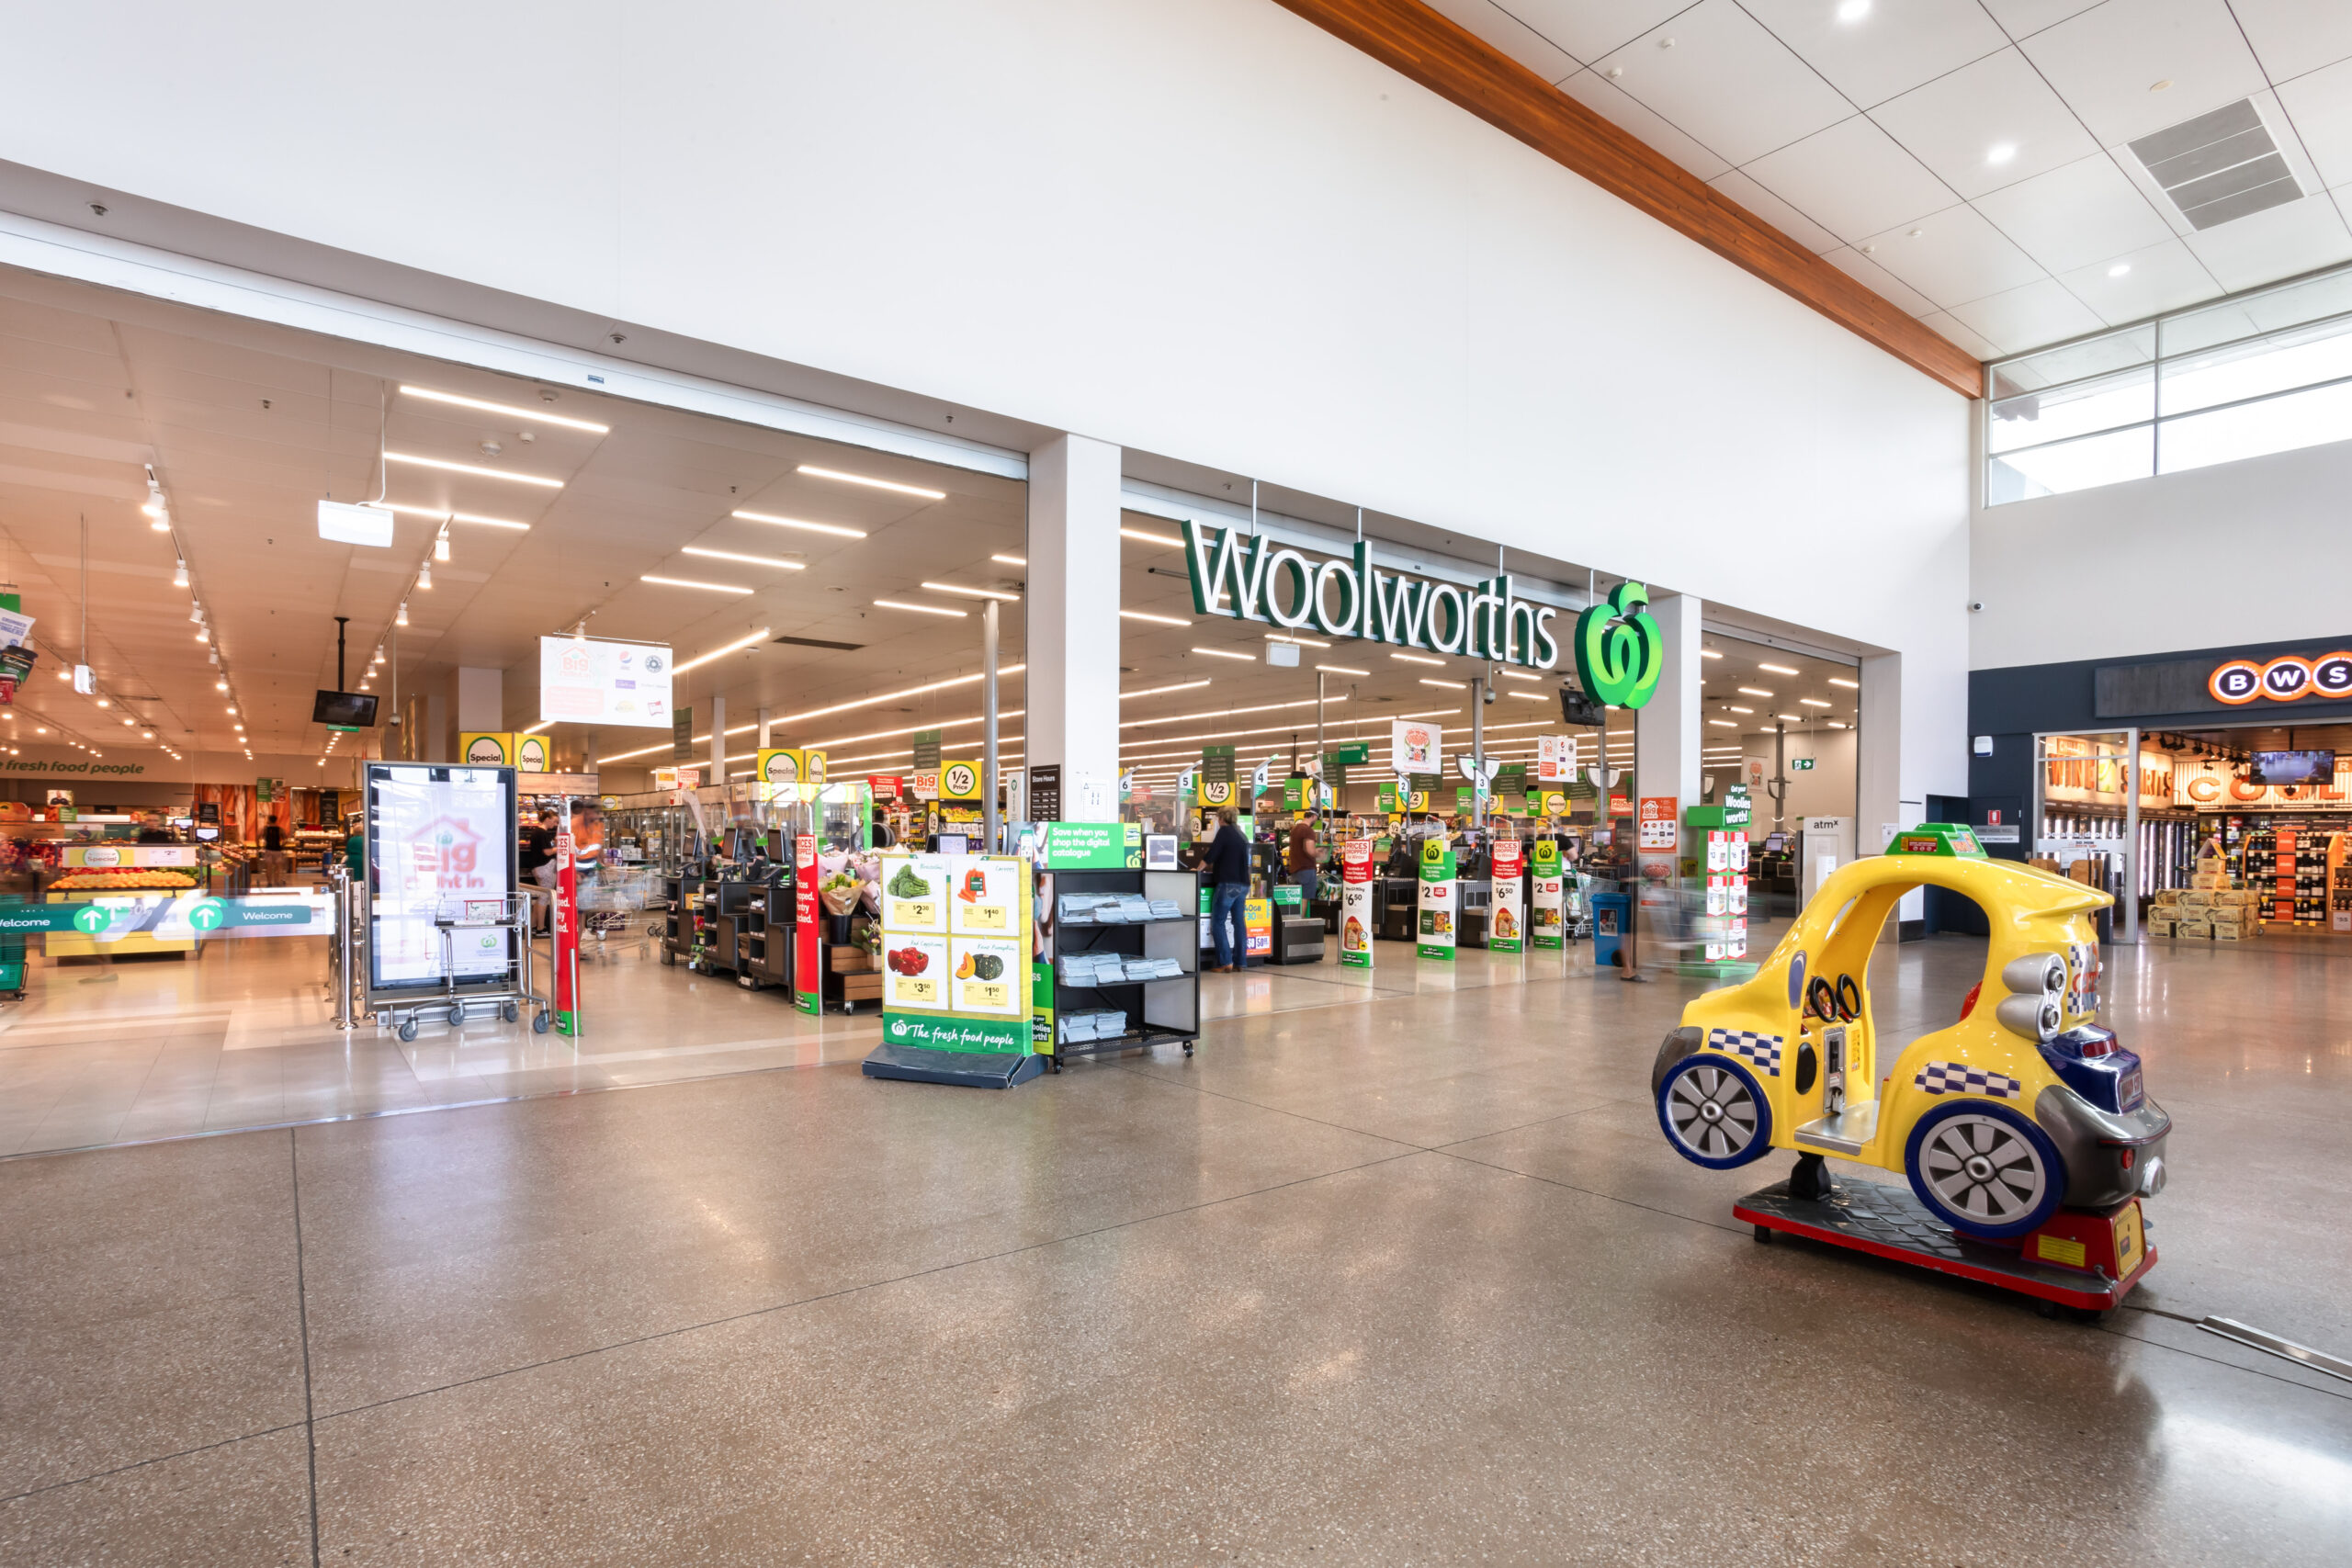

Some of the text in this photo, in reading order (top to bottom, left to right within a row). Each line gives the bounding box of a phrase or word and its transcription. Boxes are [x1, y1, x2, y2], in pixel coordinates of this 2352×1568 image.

[1181, 519, 1558, 670] Woolworths
[2229, 666, 2347, 691] BWS
[470, 753, 502, 763] Special
[522, 755, 543, 764] Special
[6, 760, 47, 772] fresh
[51, 761, 88, 773] food
[90, 762, 144, 774] people
[767, 767, 795, 776] Special
[2047, 752, 2096, 791] WINE
[916, 775, 935, 787] Big
[952, 771, 968, 784] 1/2
[1182, 777, 1189, 786] 5
[1258, 773, 1263, 783] 4
[1479, 778, 1485, 787] 3
[2120, 764, 2173, 798] SIRITS
[1122, 781, 1128, 790] 6
[1210, 782, 1225, 795] 1/2
[1401, 782, 1406, 791] 2
[1724, 795, 1751, 809] Woolies
[1725, 811, 1748, 824] worth!
[1052, 827, 1109, 840] Save when you
[1052, 838, 1110, 848] shop the digital
[1052, 848, 1091, 857] catalogue
[1421, 886, 1430, 898] $2
[1534, 882, 1544, 894] $2
[243, 910, 293, 920] Welcome
[1032, 1023, 1051, 1033] oolies
[907, 1022, 1014, 1049] The fresh food people
[1032, 1032, 1048, 1042] orth!
